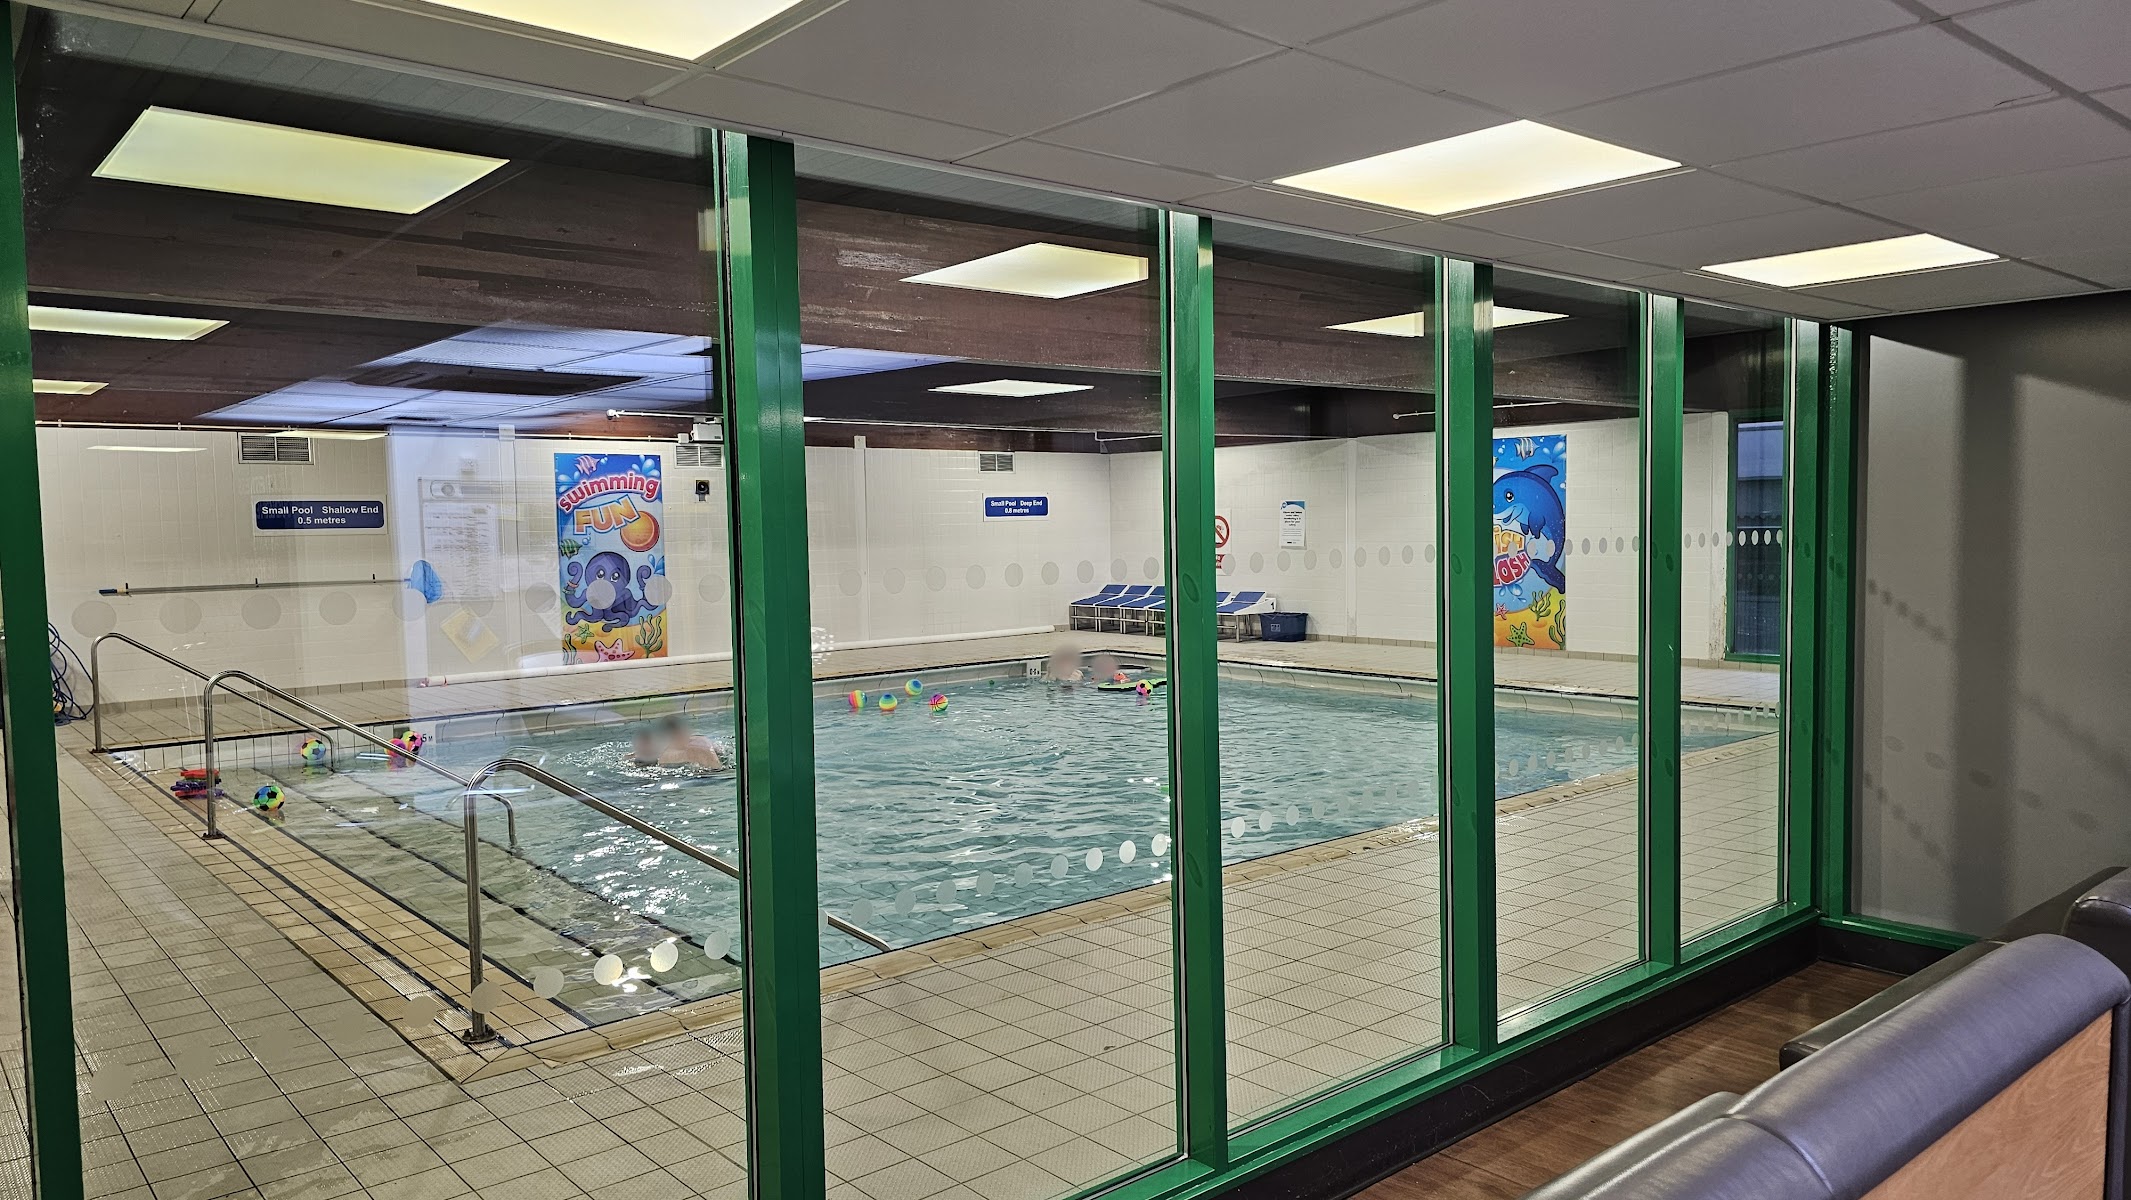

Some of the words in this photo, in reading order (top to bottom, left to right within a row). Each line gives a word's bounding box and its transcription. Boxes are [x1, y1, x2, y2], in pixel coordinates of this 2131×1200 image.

[261, 506, 289, 514] Small
[291, 506, 313, 514] Pool
[321, 505, 358, 514] Shallow
[360, 505, 379, 514] End
[574, 496, 640, 534] FUN
[297, 517, 312, 525] 0.5
